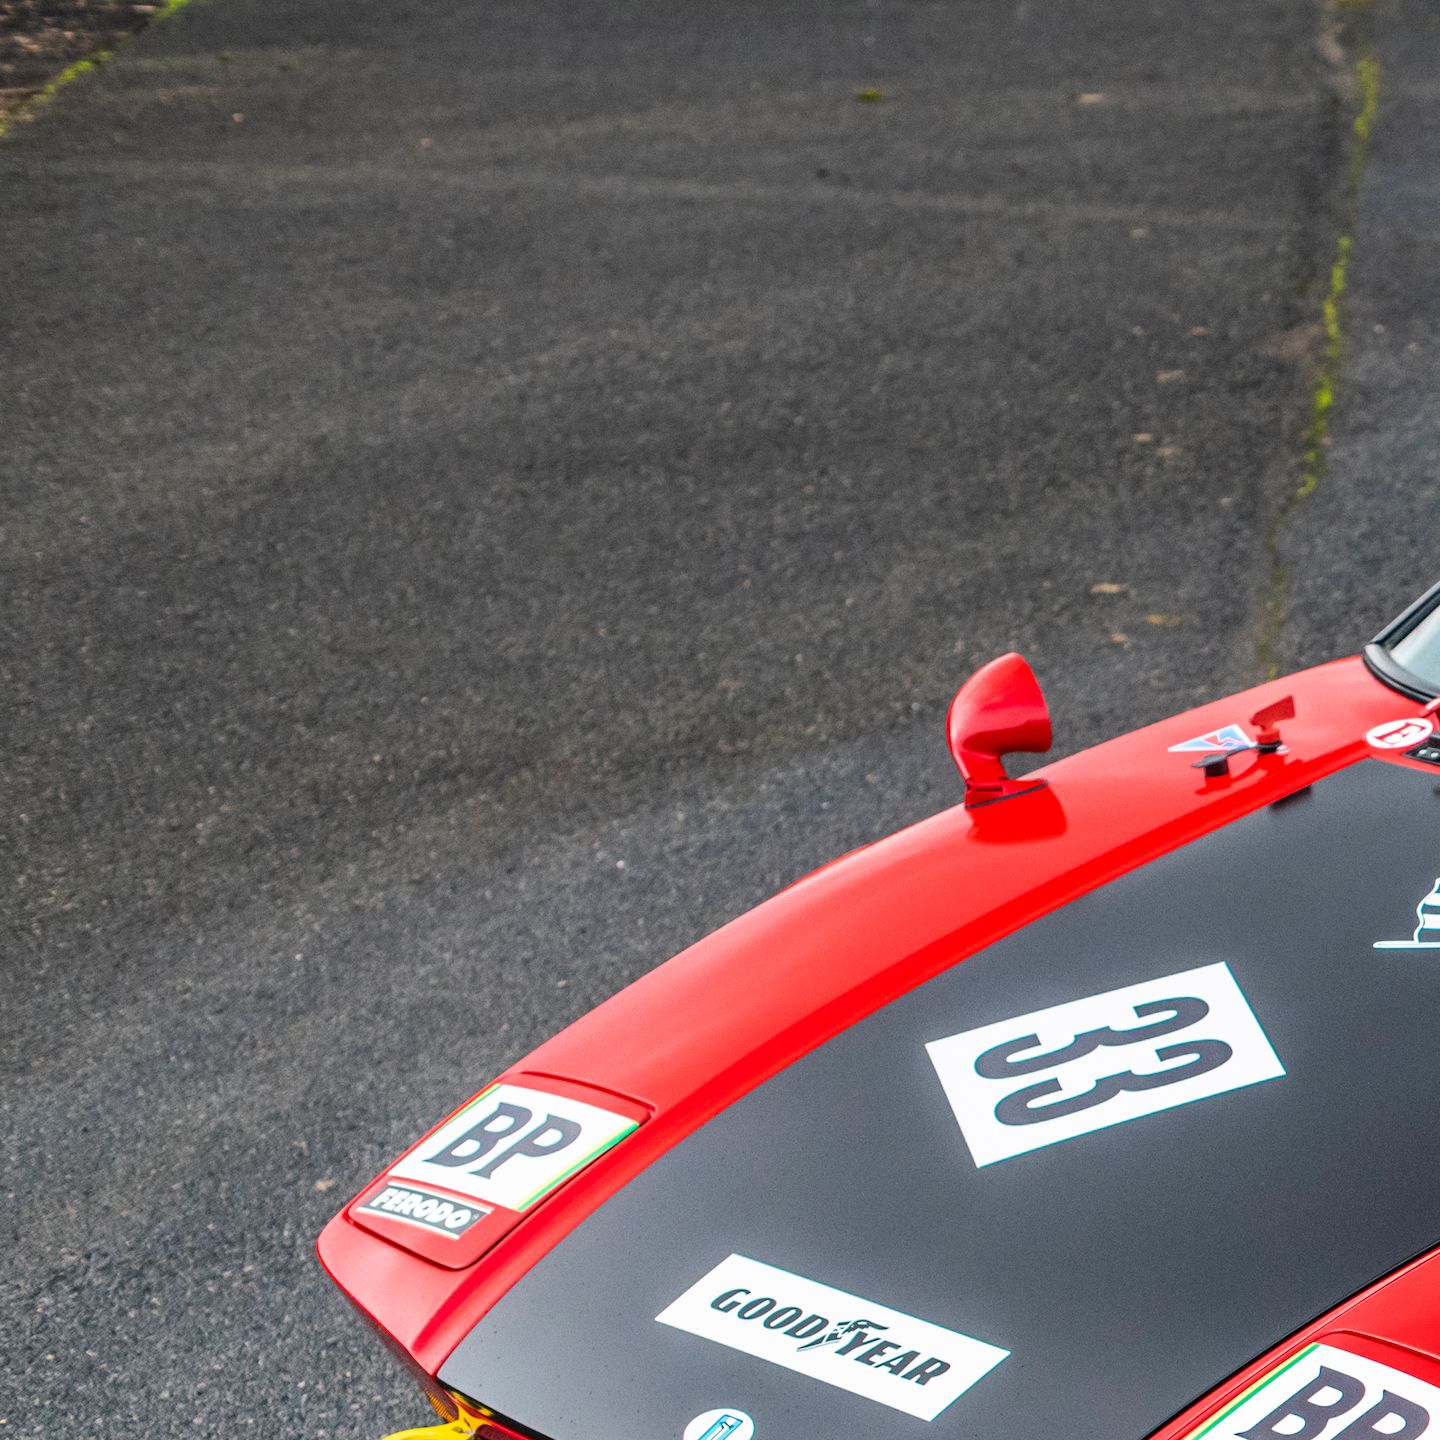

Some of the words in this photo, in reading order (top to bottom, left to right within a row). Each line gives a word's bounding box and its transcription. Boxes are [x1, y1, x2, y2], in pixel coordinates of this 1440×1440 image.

[974, 996, 1233, 1126] 33
[422, 1102, 582, 1181] BP
[369, 1187, 472, 1229] FERODO
